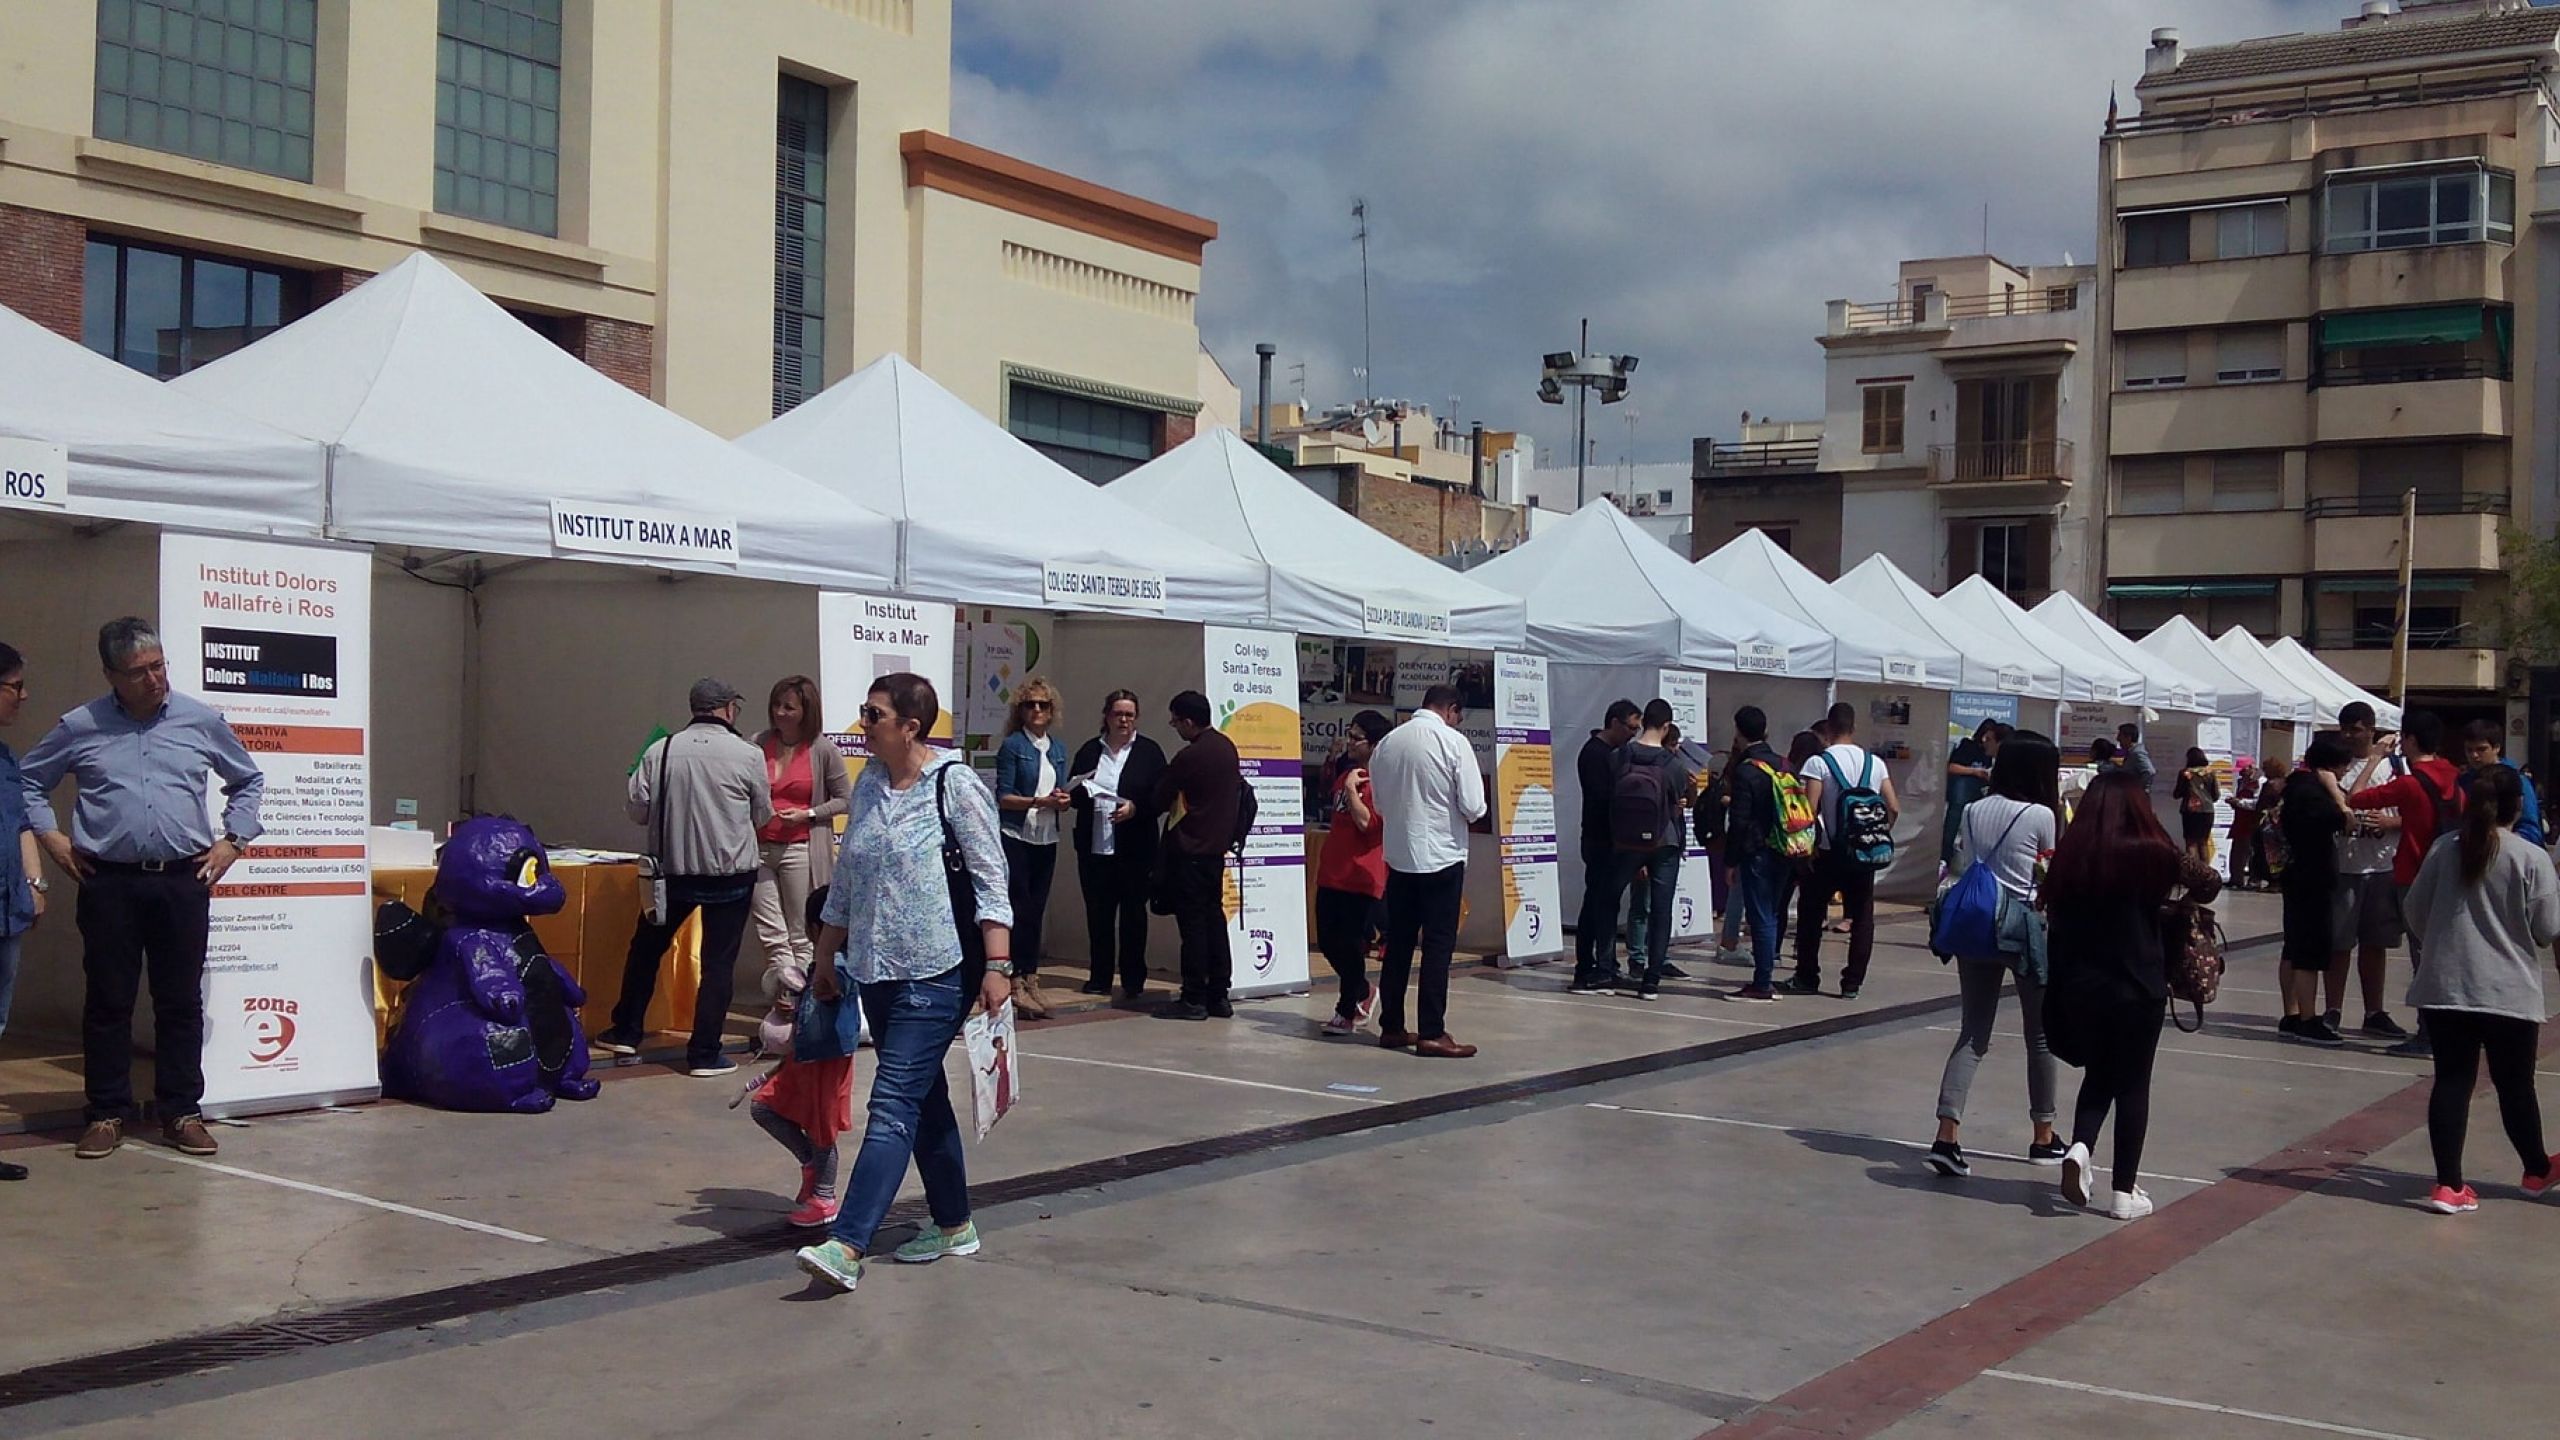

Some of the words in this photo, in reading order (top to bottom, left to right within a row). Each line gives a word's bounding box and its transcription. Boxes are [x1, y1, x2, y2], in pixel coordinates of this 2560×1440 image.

[5, 470, 45, 498] ROS
[558, 512, 634, 541] INSTITUT
[639, 520, 675, 545] BAIX
[679, 525, 690, 546] A
[694, 527, 733, 550] MAR
[200, 563, 270, 587] Institut
[275, 570, 337, 593] Dolors
[1080, 574, 1105, 595] SANTA
[1108, 576, 1130, 596] TERESA
[287, 597, 292, 615] i
[299, 599, 335, 618] Ros
[864, 600, 917, 621] Institut
[853, 624, 885, 643] Baix
[889, 632, 897, 643] a
[902, 629, 930, 646] Mar
[205, 642, 260, 661] INSTITUT
[1222, 661, 1249, 675] Santa
[1252, 663, 1282, 677] Teresa
[206, 667, 246, 685] Dolors
[309, 675, 333, 690] Ros
[1233, 681, 1244, 693] de
[295, 776, 334, 784] Modalitat
[296, 787, 325, 797] Imatge
[331, 787, 364, 797] Disseny
[338, 799, 364, 807] Dansa
[262, 813, 273, 821] de
[318, 813, 364, 822] Tecnologia
[334, 828, 365, 836] Socials
[250, 848, 272, 857] DEL
[275, 847, 318, 857] CENTRE
[216, 886, 238, 896] DEL
[242, 885, 288, 895] CENTRE
[209, 915, 235, 923] Doctor
[224, 924, 257, 932] Vilanova
[1249, 929, 1274, 940] zona
[244, 997, 298, 1015] zona
